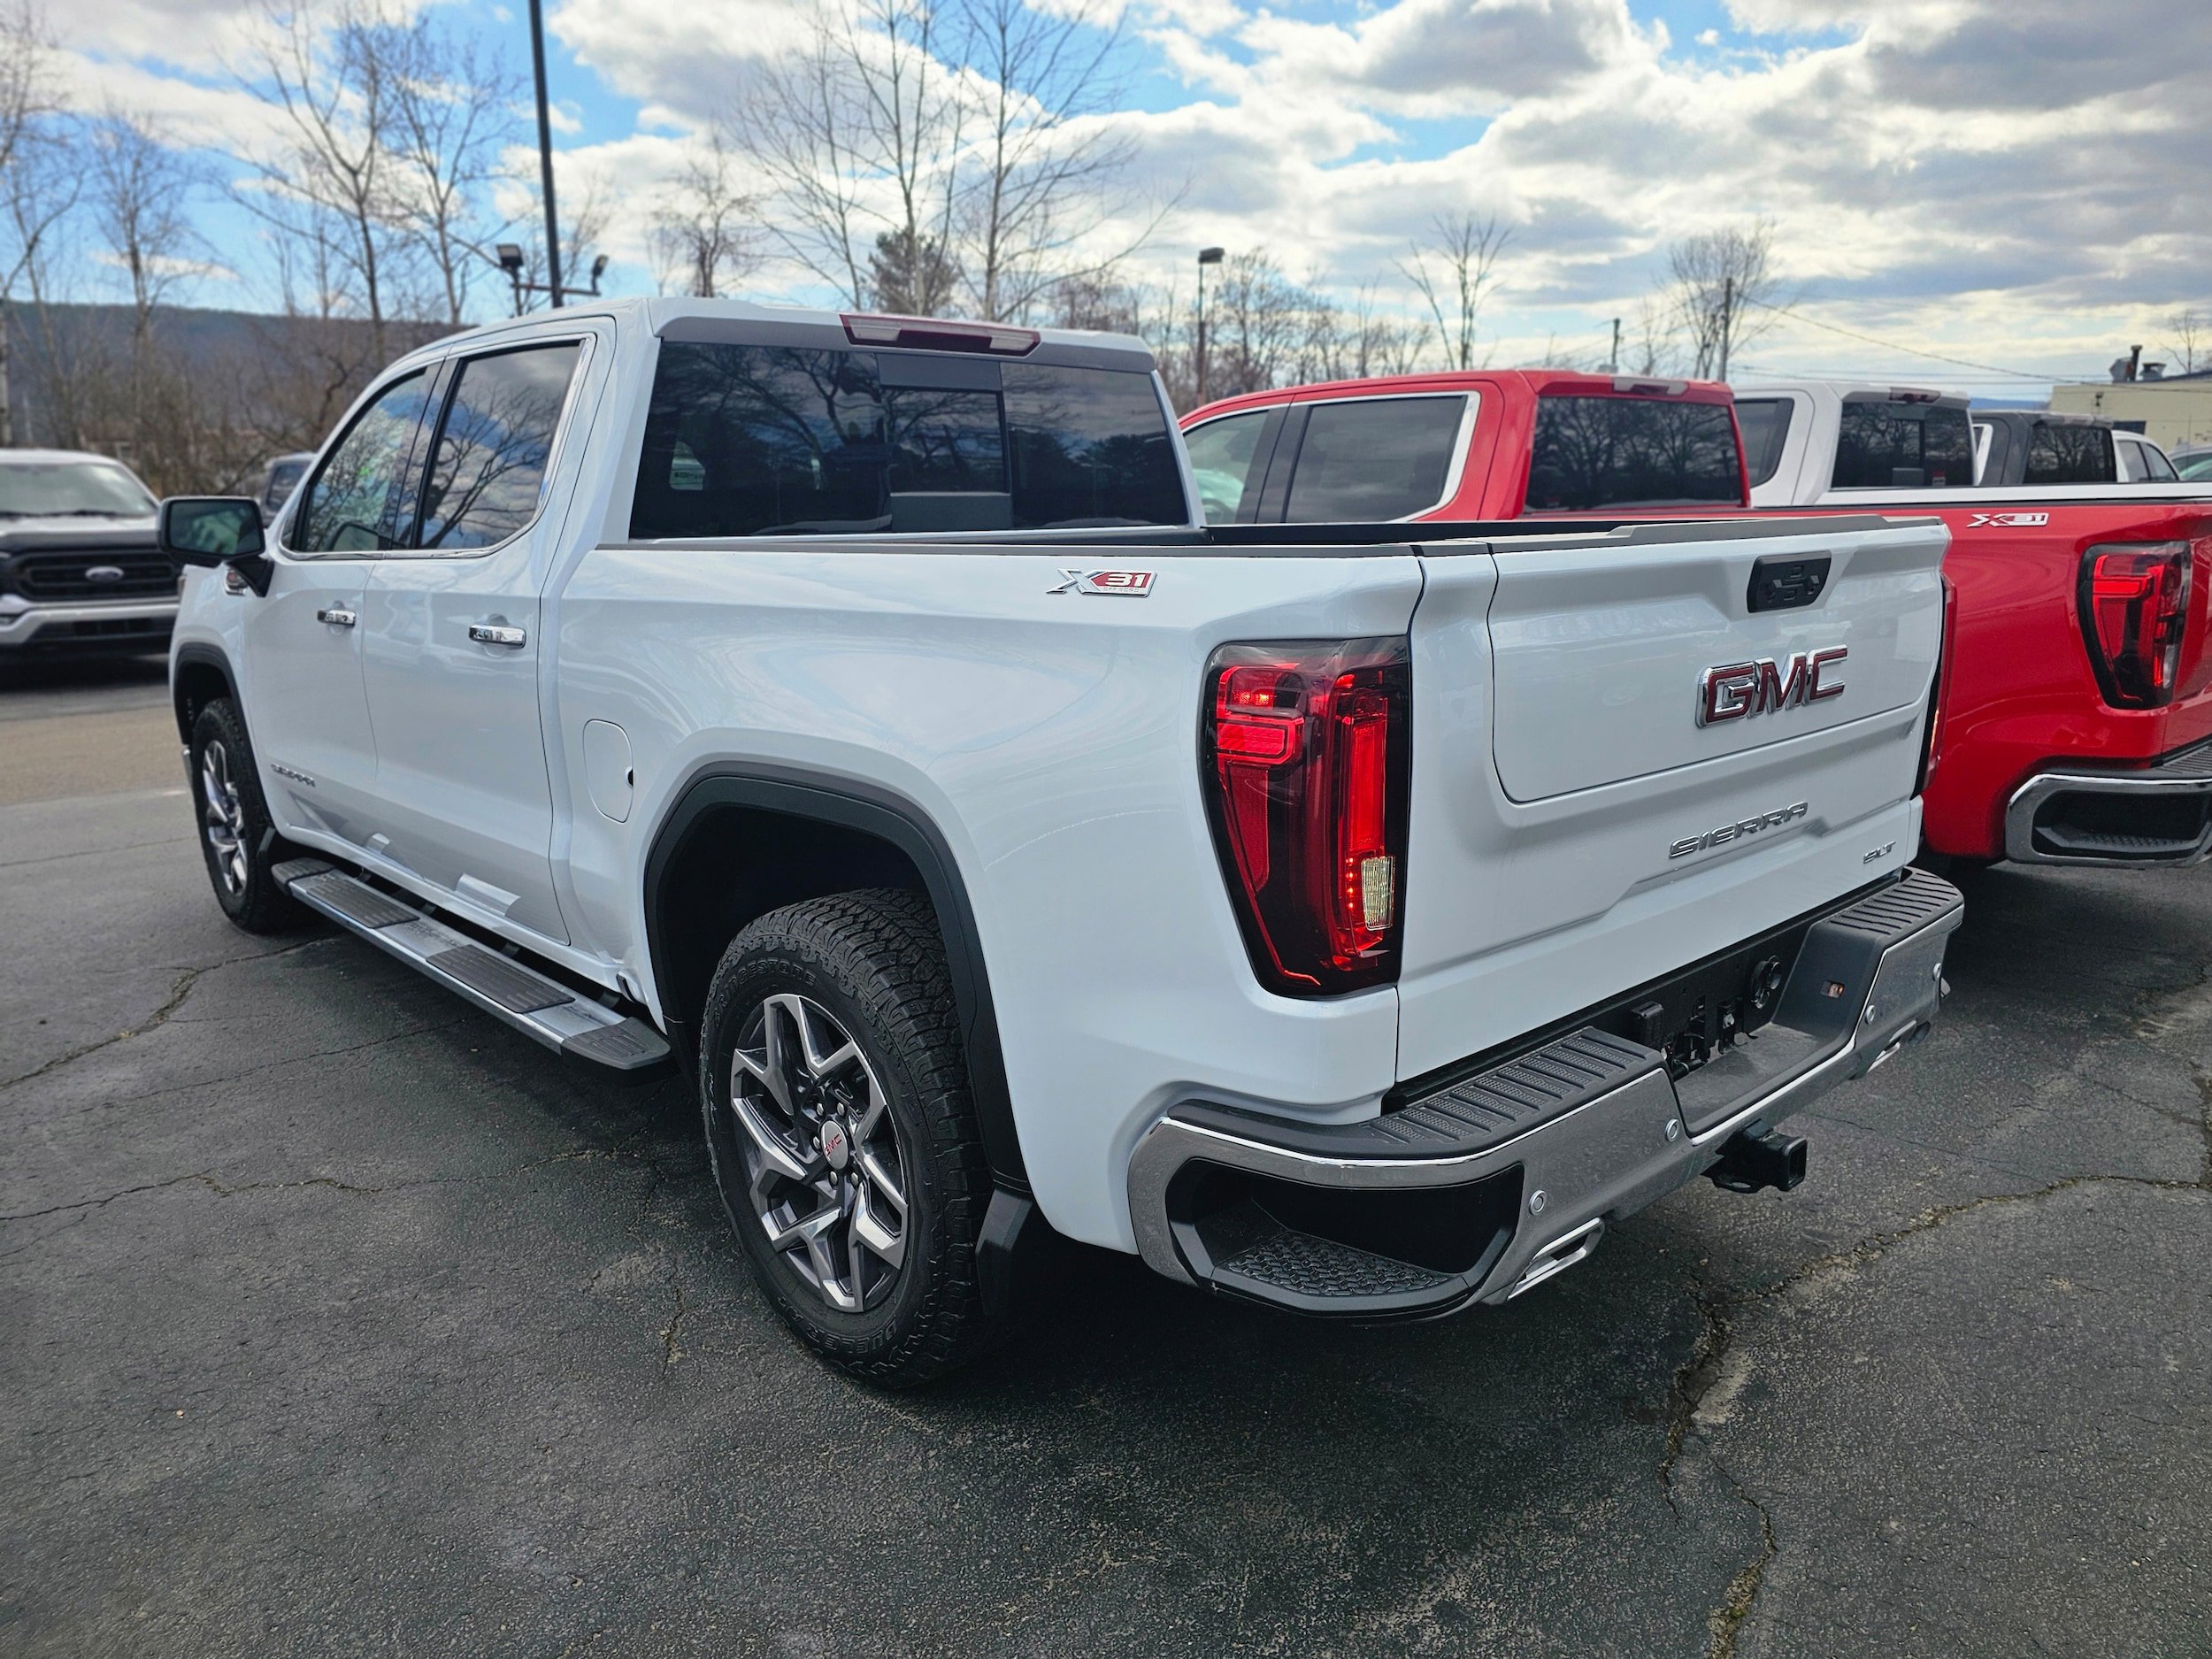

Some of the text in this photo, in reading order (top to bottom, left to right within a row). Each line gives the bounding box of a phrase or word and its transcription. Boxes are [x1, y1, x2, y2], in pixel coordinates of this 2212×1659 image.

[1046, 568, 1150, 596] X31
[1695, 644, 1847, 728] GMC
[1669, 801, 1809, 859] SIERRA
[1863, 841, 1896, 864] SLT
[806, 1314, 897, 1354] DUELER
